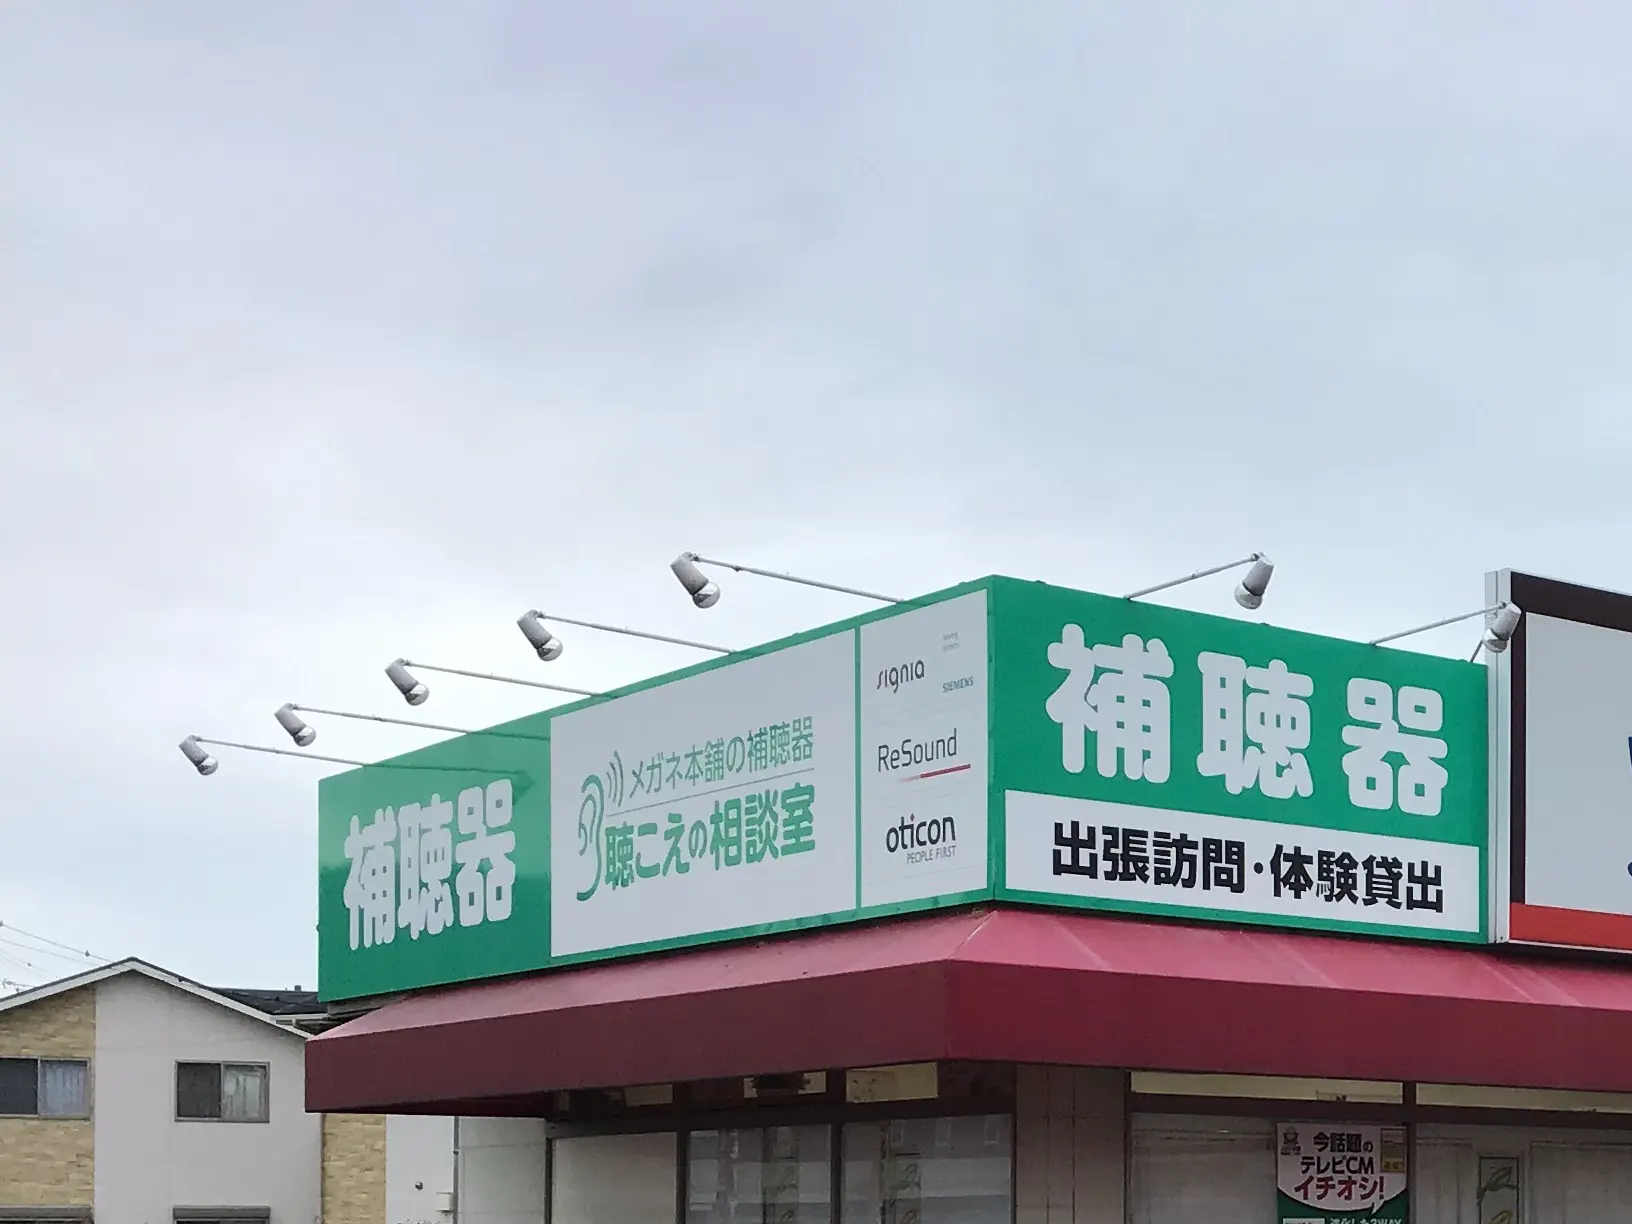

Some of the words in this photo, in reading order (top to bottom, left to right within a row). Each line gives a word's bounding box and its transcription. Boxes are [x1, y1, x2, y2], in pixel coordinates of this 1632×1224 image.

[877, 660, 925, 694] signia
[1045, 623, 1450, 817] 補聴器
[630, 715, 814, 799] メガネ本舗の補聴器
[878, 728, 957, 772] ReSound
[604, 783, 817, 892] 聴こえの相談室
[886, 813, 956, 853] oticon
[907, 849, 933, 864] PEOPLE
[935, 845, 956, 859] FIRST
[343, 779, 517, 950] 補聴器
[1052, 820, 1444, 914] 出張訪問・体験貸出
[1313, 1131, 1374, 1153] 今話題の
[1300, 1155, 1375, 1175] テレビCM
